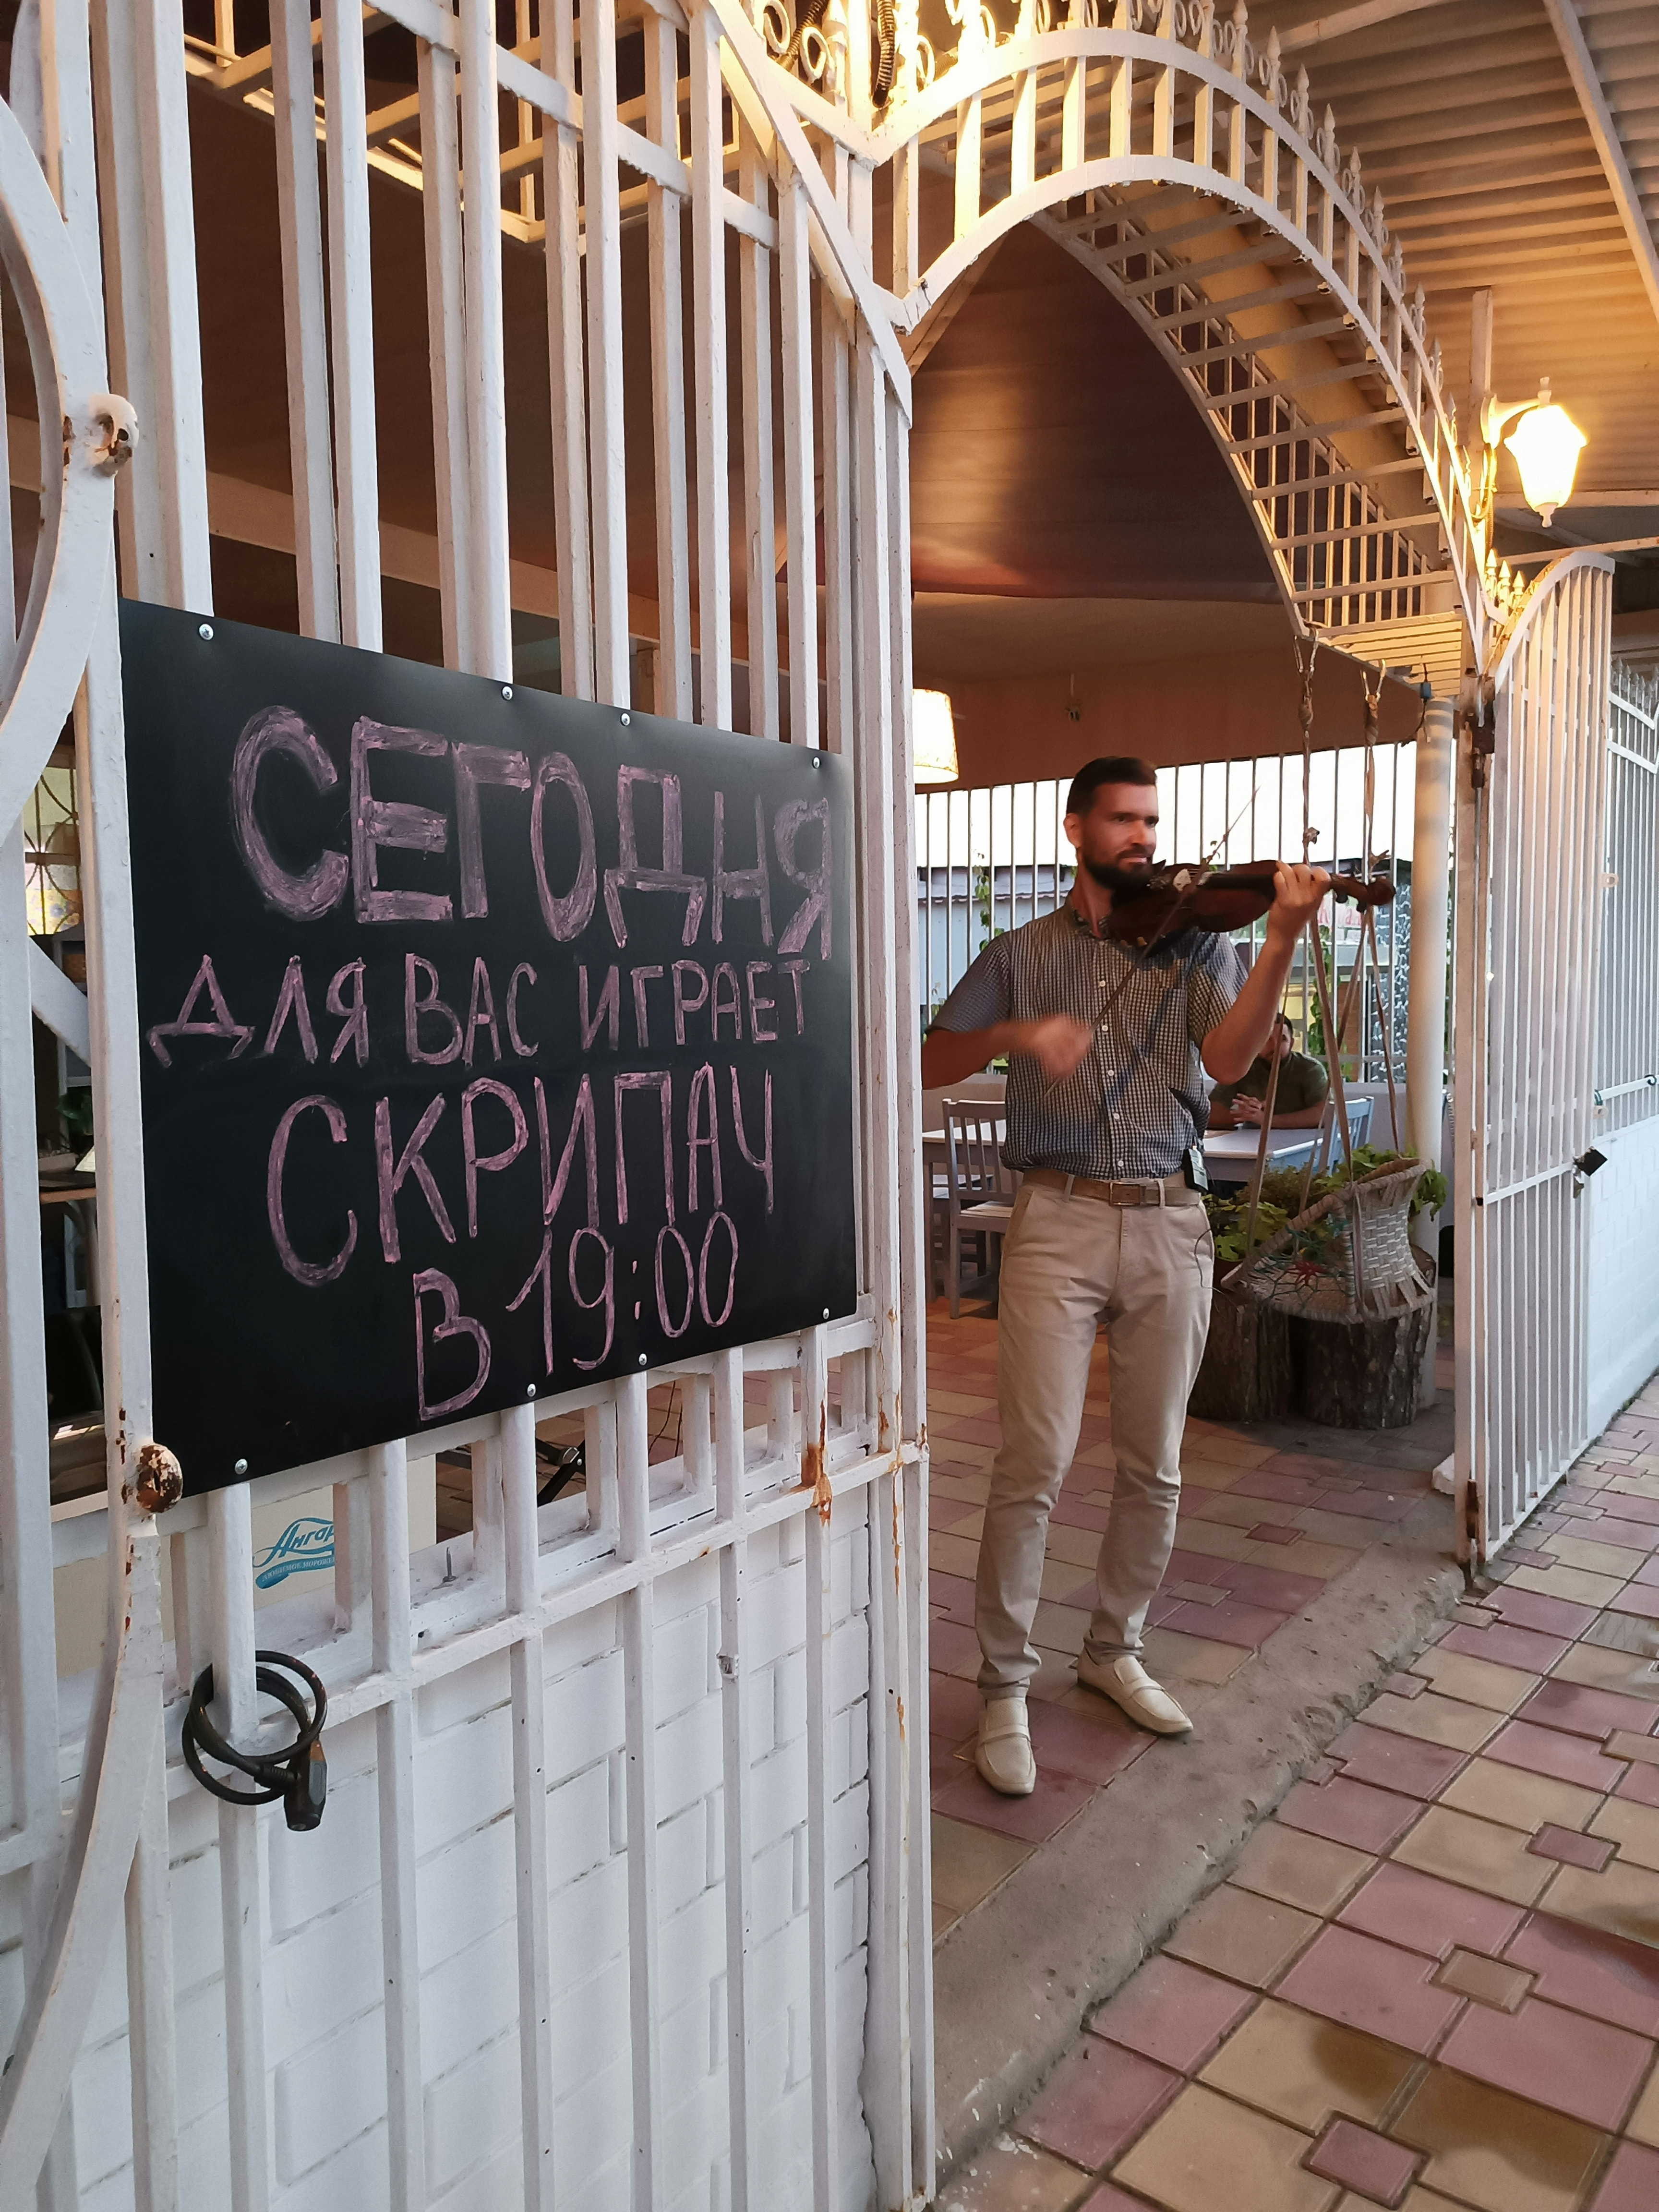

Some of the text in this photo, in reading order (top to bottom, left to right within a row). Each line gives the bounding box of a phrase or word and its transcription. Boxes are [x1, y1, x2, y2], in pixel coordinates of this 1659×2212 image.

[229, 705, 833, 960] СЕГОДНЯ
[146, 953, 810, 1068] ДЛЯ ВАС ИГРАЕТ
[267, 1062, 774, 1287] СКРИПАЧ
[412, 1211, 739, 1421] В 19:00
